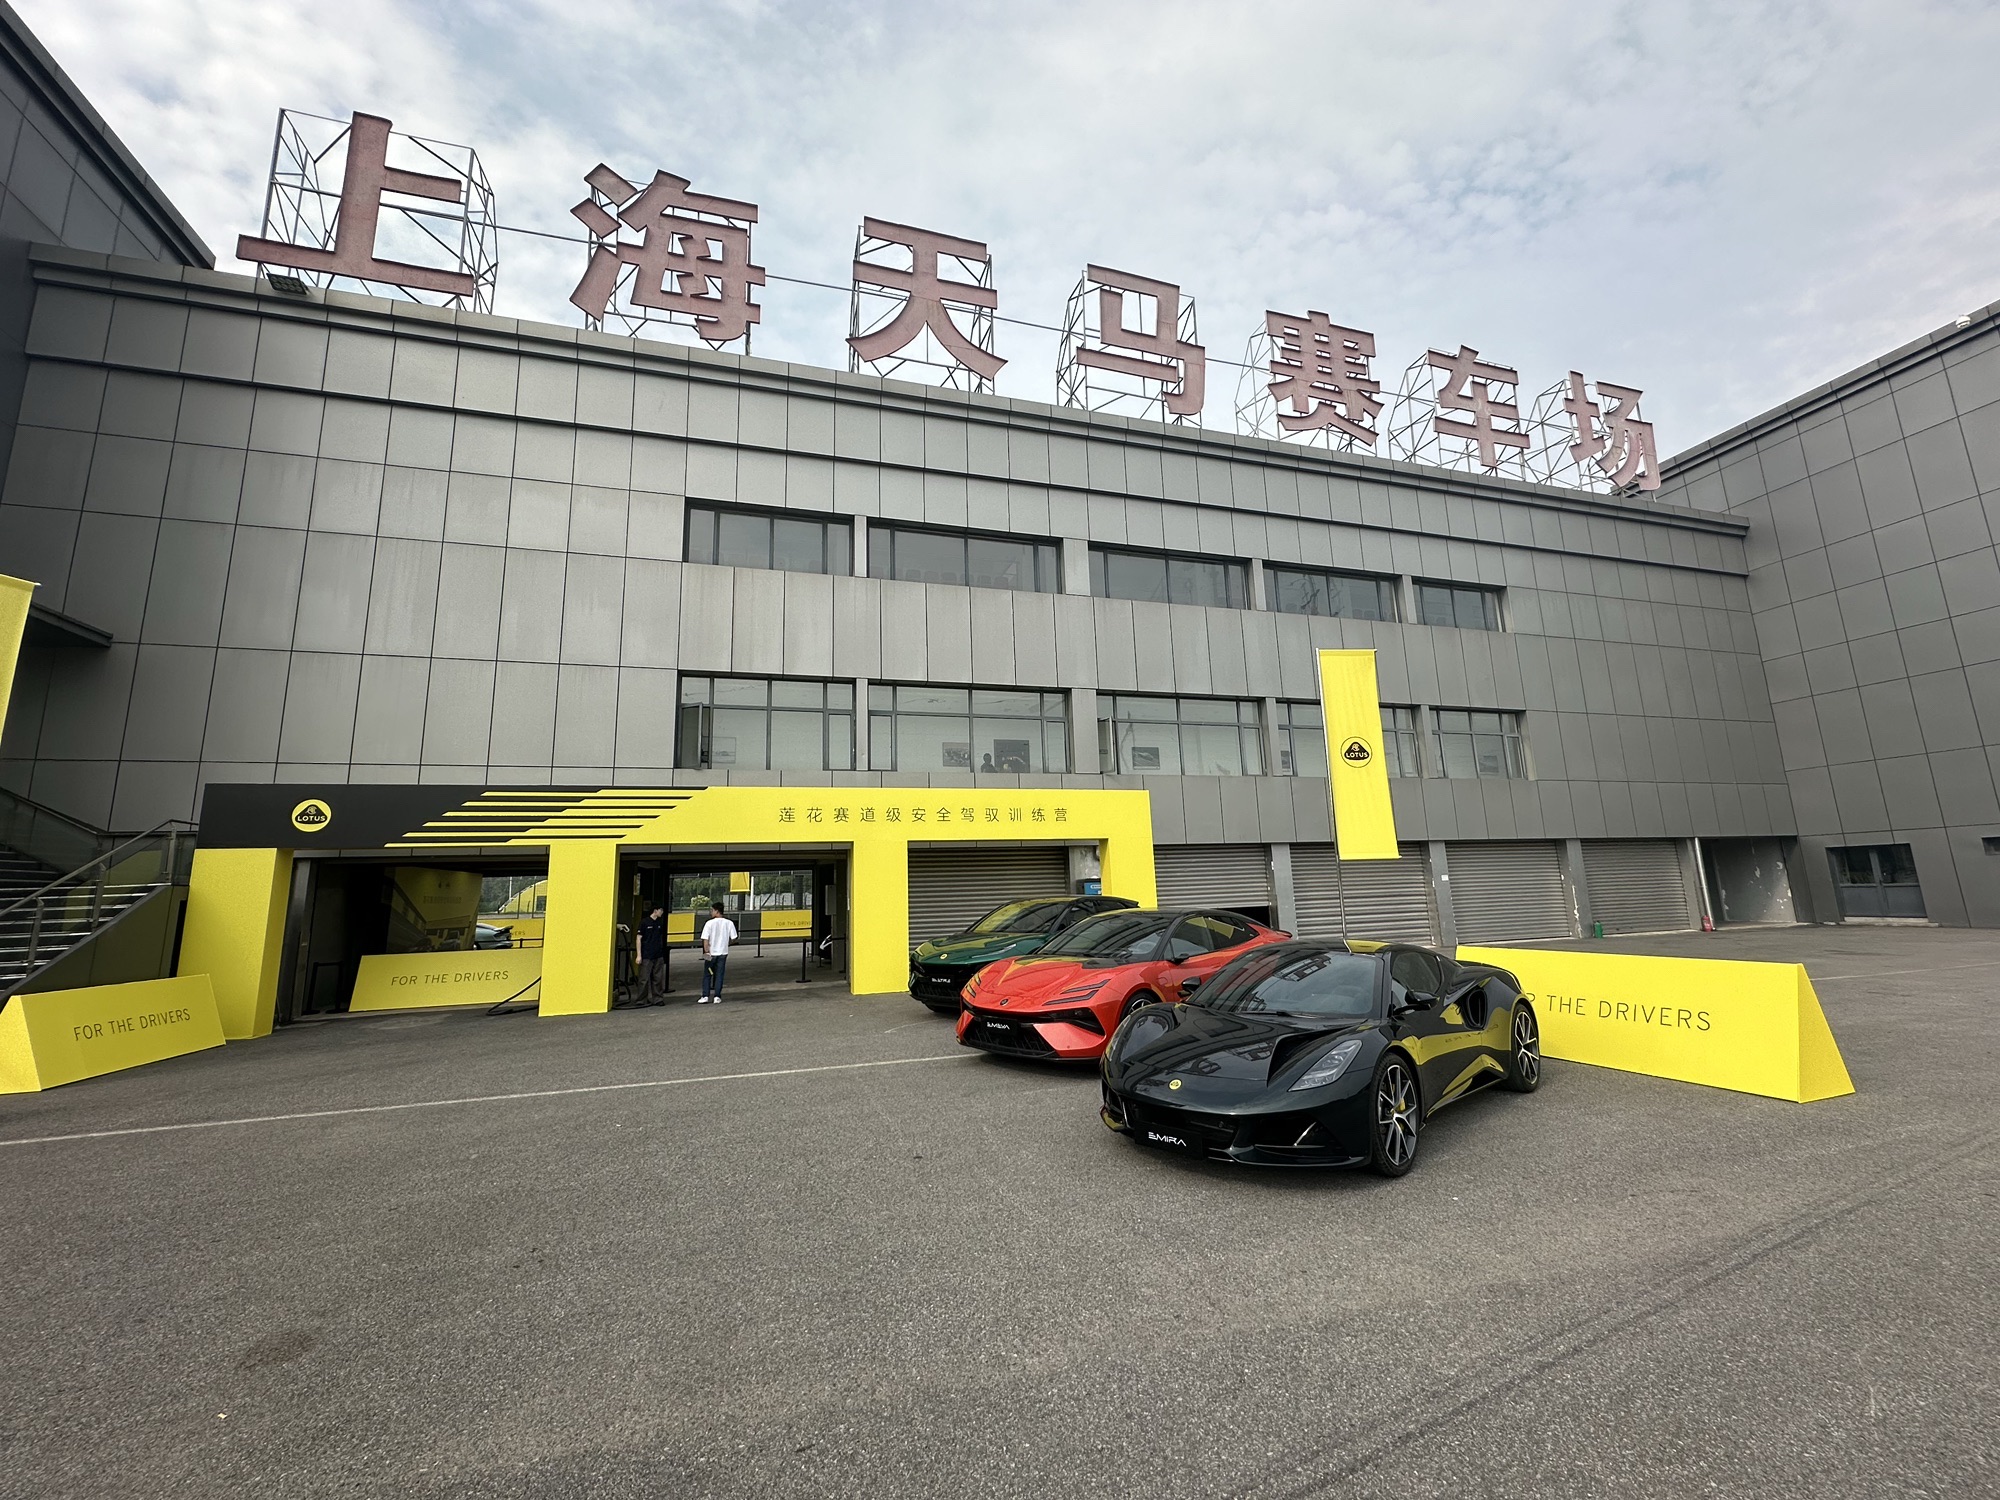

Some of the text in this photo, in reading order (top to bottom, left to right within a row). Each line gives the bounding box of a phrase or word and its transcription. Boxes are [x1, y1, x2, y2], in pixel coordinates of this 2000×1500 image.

[236, 110, 1661, 492] 上海天马赛车场
[778, 806, 1068, 824] 莲花赛道级安全驾驭训练营
[391, 970, 509, 986] FOR THE DRIVERS
[73, 1008, 191, 1041] FOR THE DRIVERS
[1546, 994, 1586, 1016] THE
[1598, 1000, 1711, 1031] DRIVERS
[1147, 1131, 1187, 1147] EMIRA
